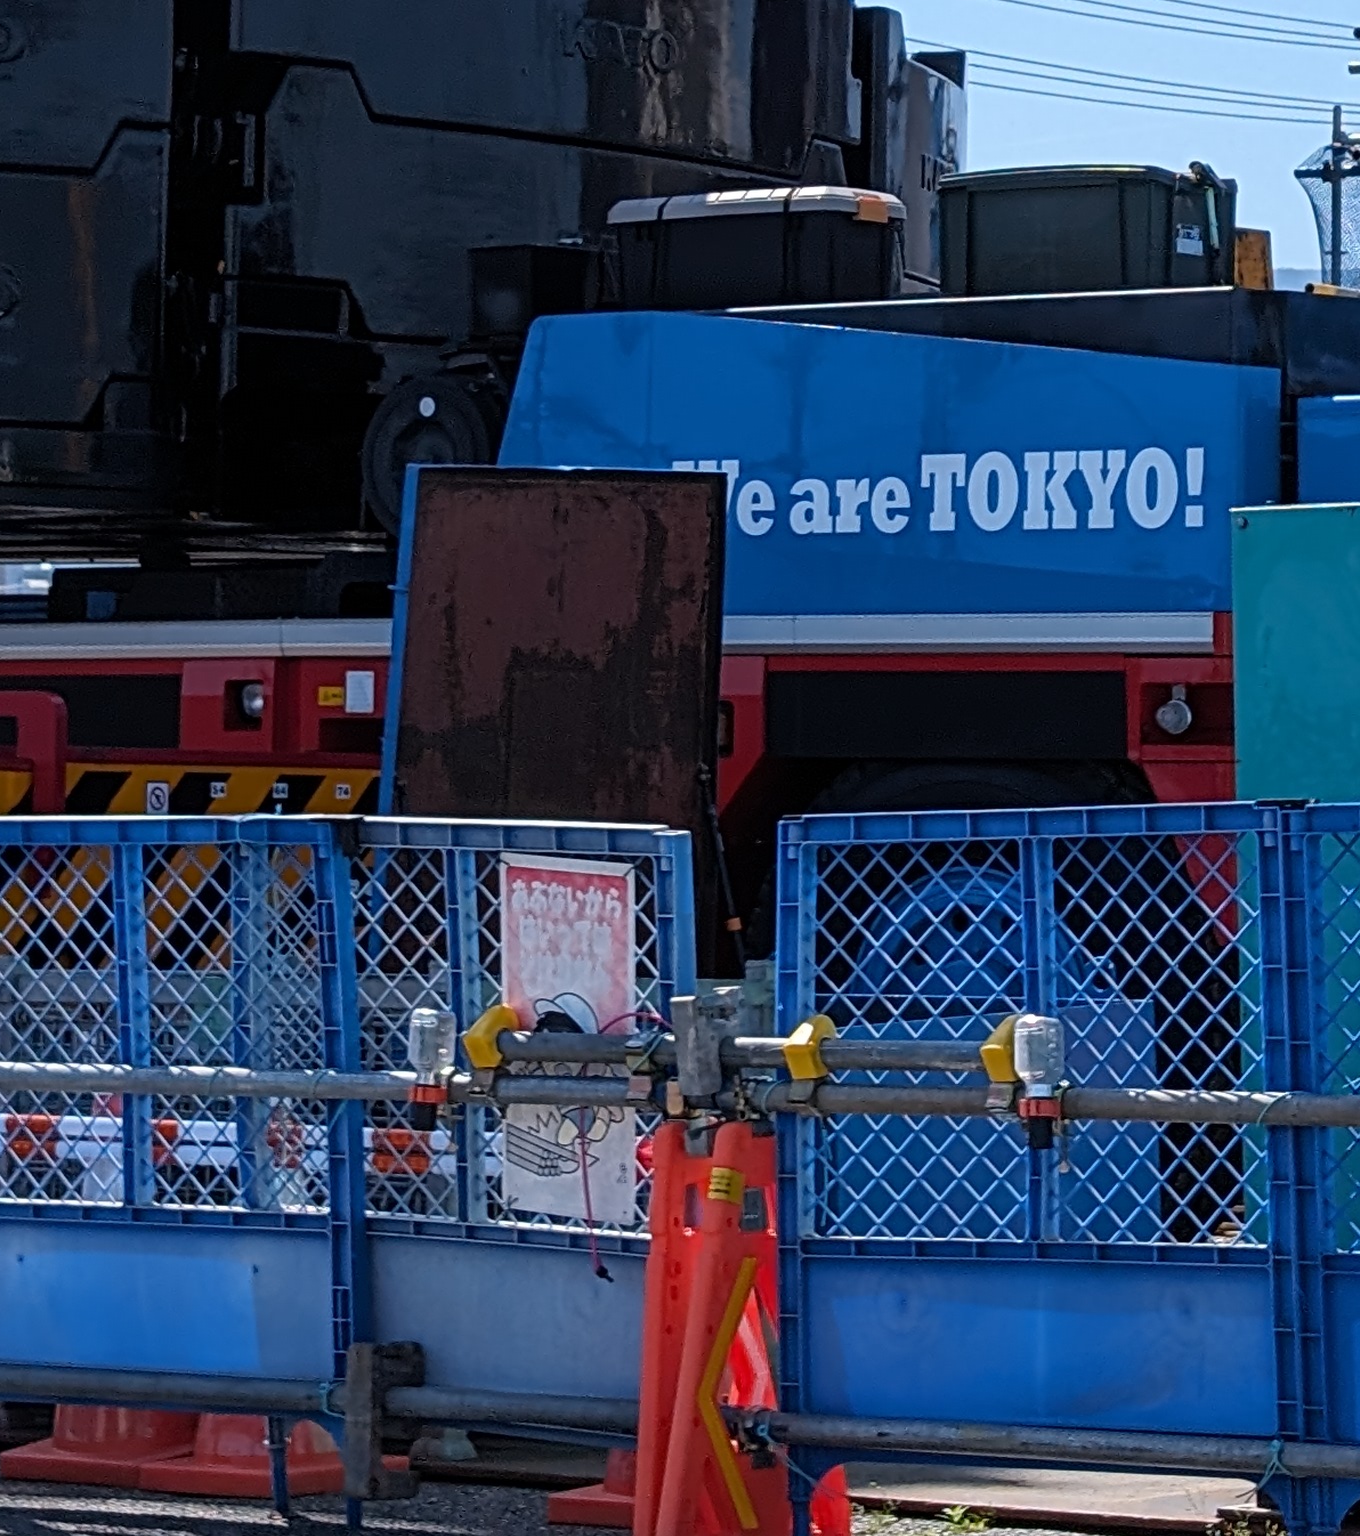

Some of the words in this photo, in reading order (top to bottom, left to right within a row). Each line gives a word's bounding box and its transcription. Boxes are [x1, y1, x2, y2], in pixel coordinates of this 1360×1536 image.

[789, 476, 911, 535] are
[920, 447, 1205, 532] TOKYO!
[337, 786, 350, 798] 74
[511, 878, 623, 920] あぶないから
